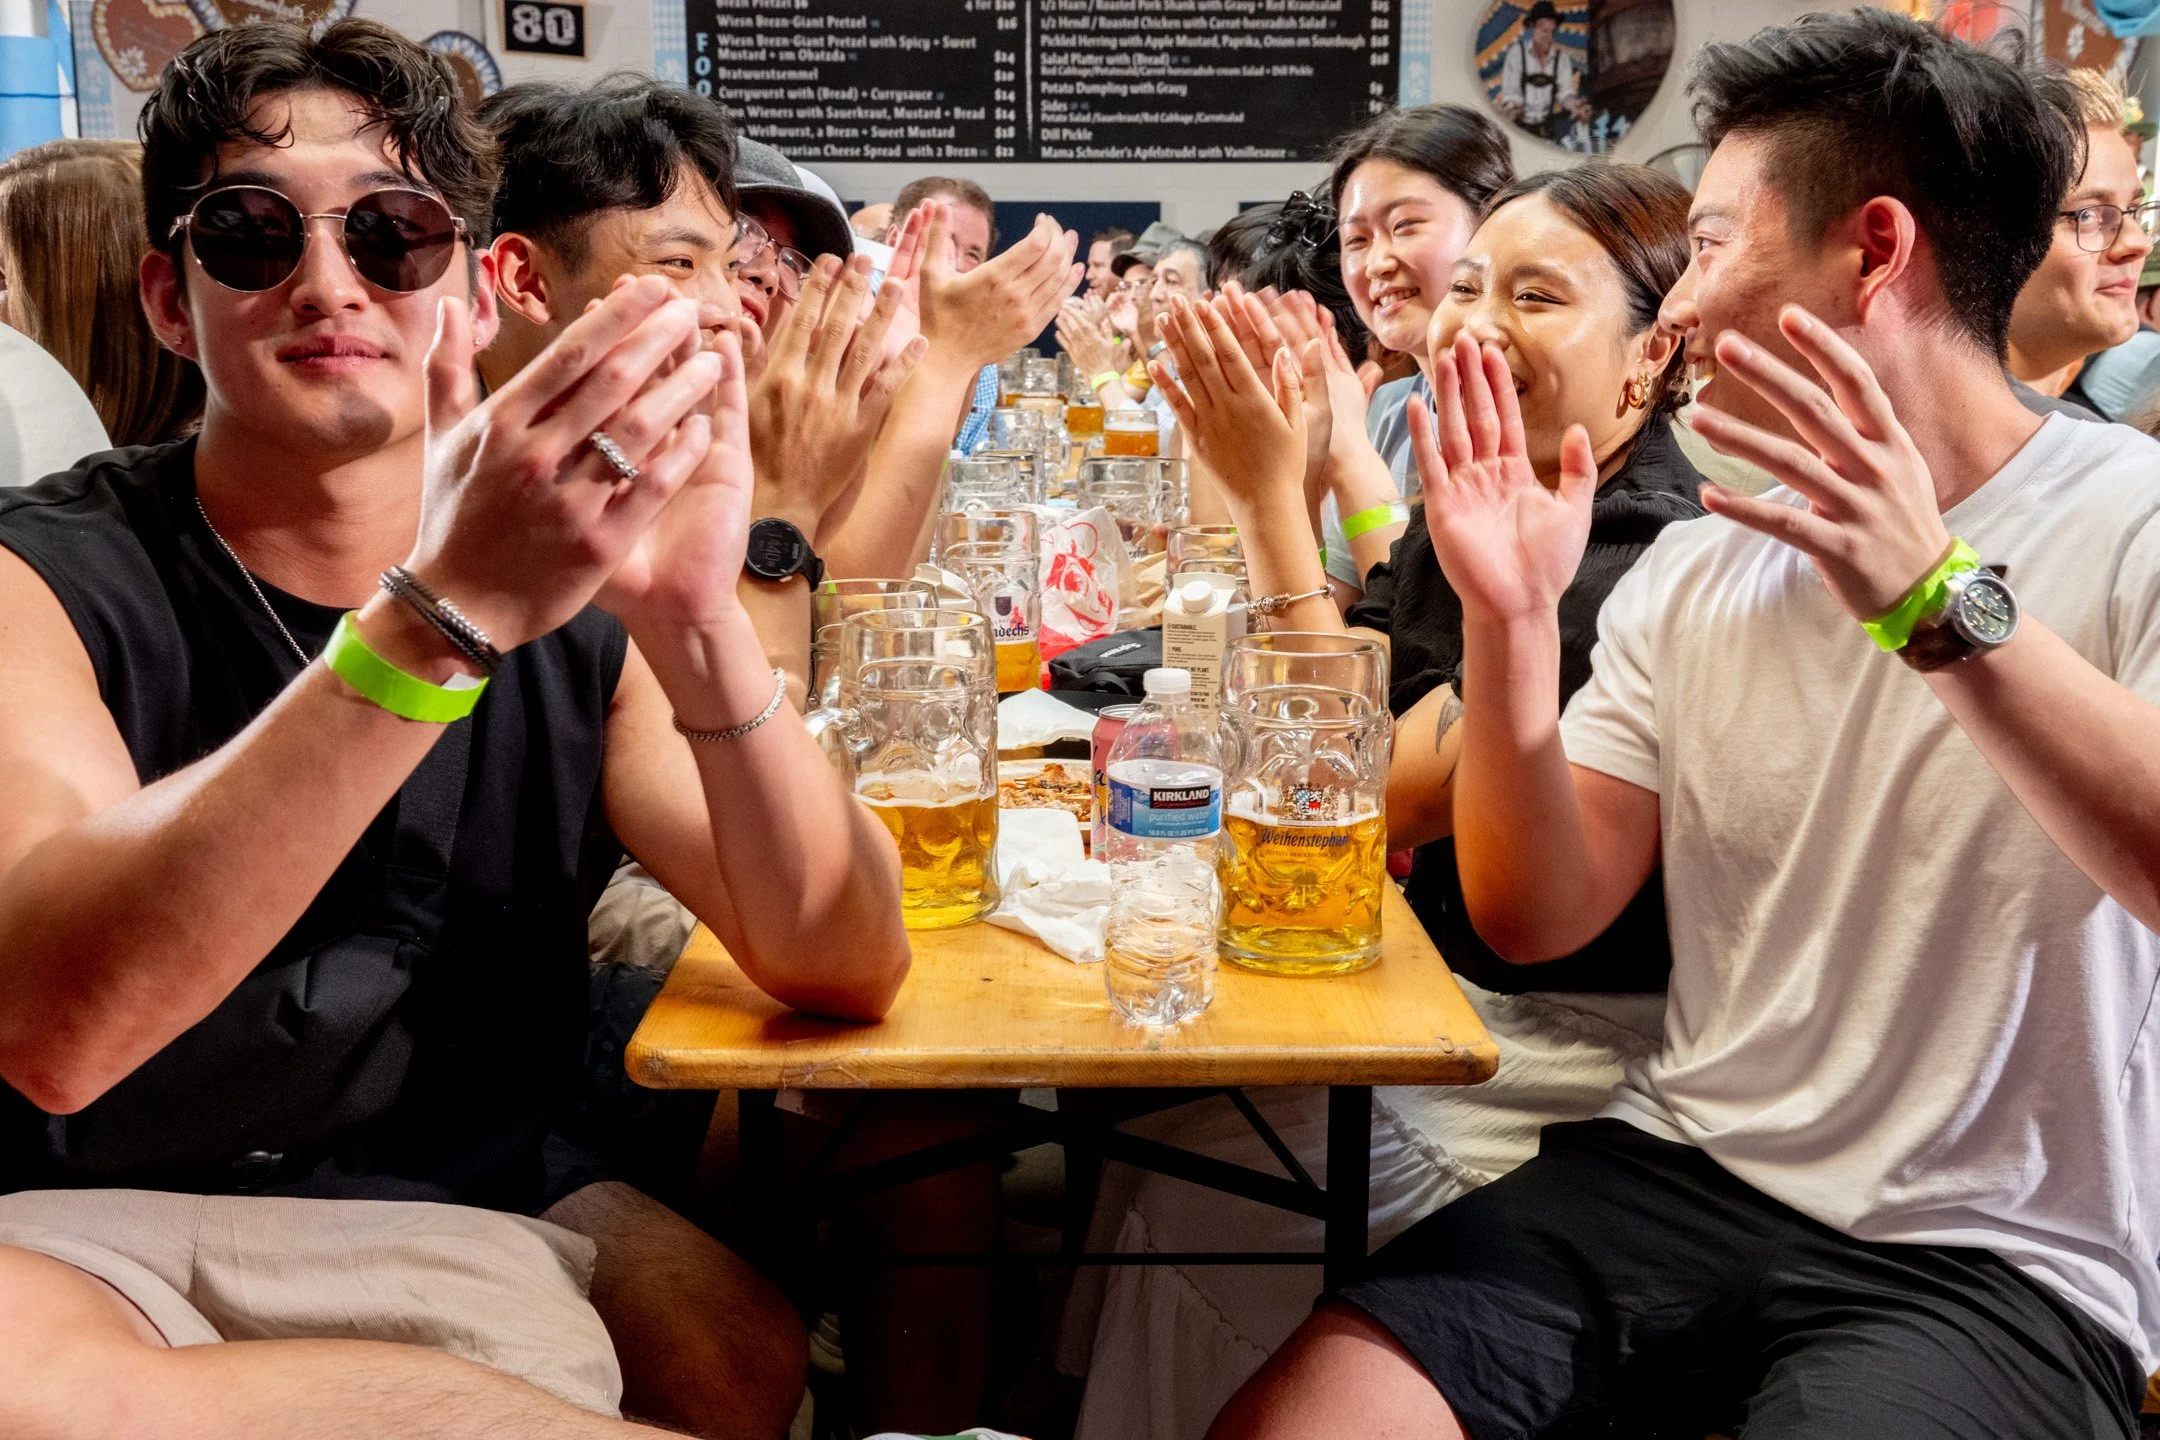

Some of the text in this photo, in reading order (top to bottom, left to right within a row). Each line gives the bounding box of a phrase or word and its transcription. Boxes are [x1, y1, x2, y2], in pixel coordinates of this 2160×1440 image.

[1198, 0, 1222, 11] with
[512, 4, 576, 46] 80
[827, 15, 867, 28] Pretzel
[1099, 17, 1139, 29] Roasted
[1141, 17, 1182, 29] Chicken
[1183, 17, 1208, 29] with
[1299, 17, 1327, 29] Salad
[828, 35, 867, 48] Pretzel
[870, 35, 897, 48] with
[899, 35, 931, 51] Spicy
[943, 35, 976, 49] Sweet
[1041, 34, 1077, 47] Pickled
[1078, 34, 1118, 50] Herring
[1119, 35, 1144, 47] with
[1145, 35, 1174, 50] Apple
[718, 49, 767, 61] Mustard
[1041, 53, 1069, 65] Salad
[1106, 53, 1131, 65] with
[719, 86, 785, 101] Currywurst
[787, 87, 815, 99] with
[817, 87, 858, 101] (Bread)
[871, 87, 933, 103] Currysauce
[1041, 82, 1188, 97] Potato Dumpling with Gravy
[1041, 100, 1068, 111] Sides
[747, 106, 794, 118] Wieners
[796, 107, 824, 118] with
[894, 107, 941, 119] Mustard
[954, 107, 985, 119] Bread
[1041, 112, 1068, 123] Potato
[1069, 112, 1092, 123] Salad
[826, 125, 859, 138] Brezn
[871, 125, 905, 138] Sweet
[908, 125, 956, 138] Mustard
[1041, 128, 1093, 141] Dill Pickle
[823, 144, 862, 157] Cheese
[864, 144, 902, 159] Spread
[907, 145, 935, 157] with
[946, 145, 978, 158] Brezn
[1041, 146, 1075, 158] Mama
[1076, 146, 1133, 158] Schneider's
[1134, 146, 1197, 160] Apfelstrudel
[1198, 146, 1223, 158] with
[1153, 788, 1211, 802] KIRKLAND
[1148, 809, 1209, 822] purified water
